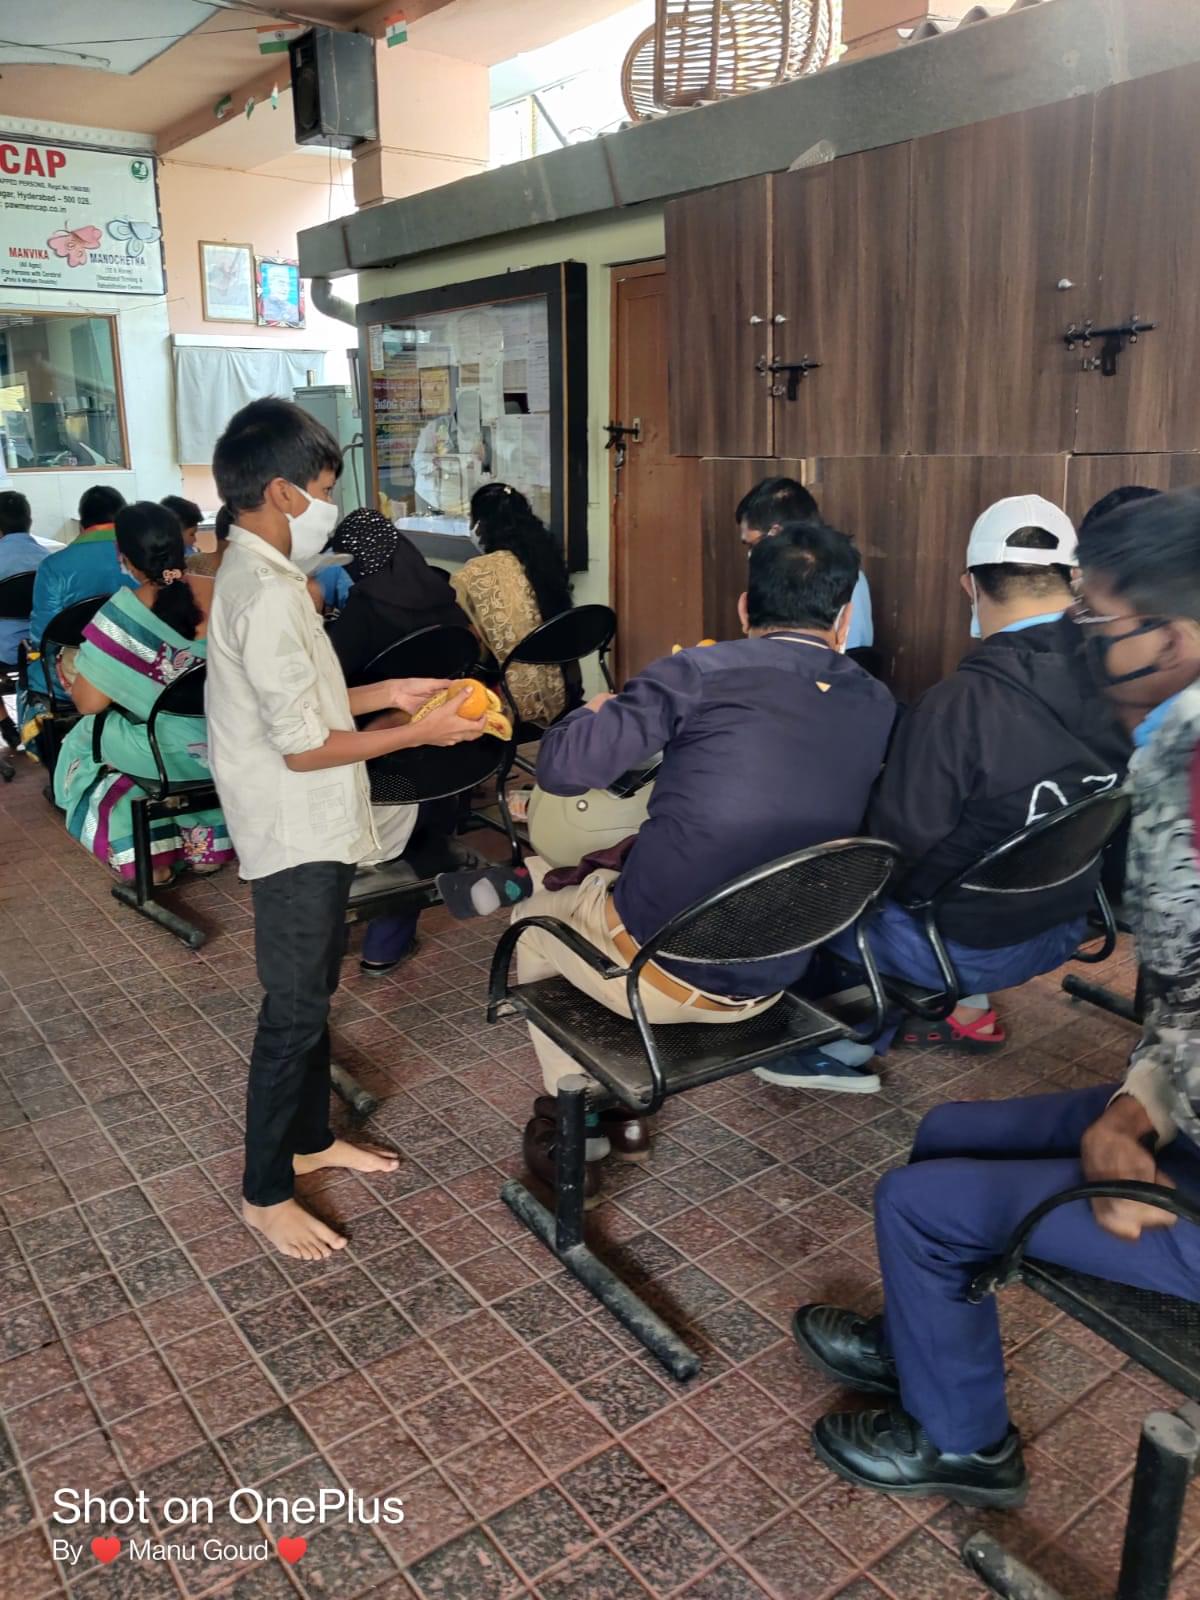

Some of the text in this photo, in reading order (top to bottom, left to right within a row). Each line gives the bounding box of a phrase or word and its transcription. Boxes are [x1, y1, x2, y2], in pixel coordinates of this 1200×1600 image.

[0, 144, 66, 178] CAP
[17, 191, 56, 202] Hyderabad
[8, 247, 49, 260] MANVIKA
